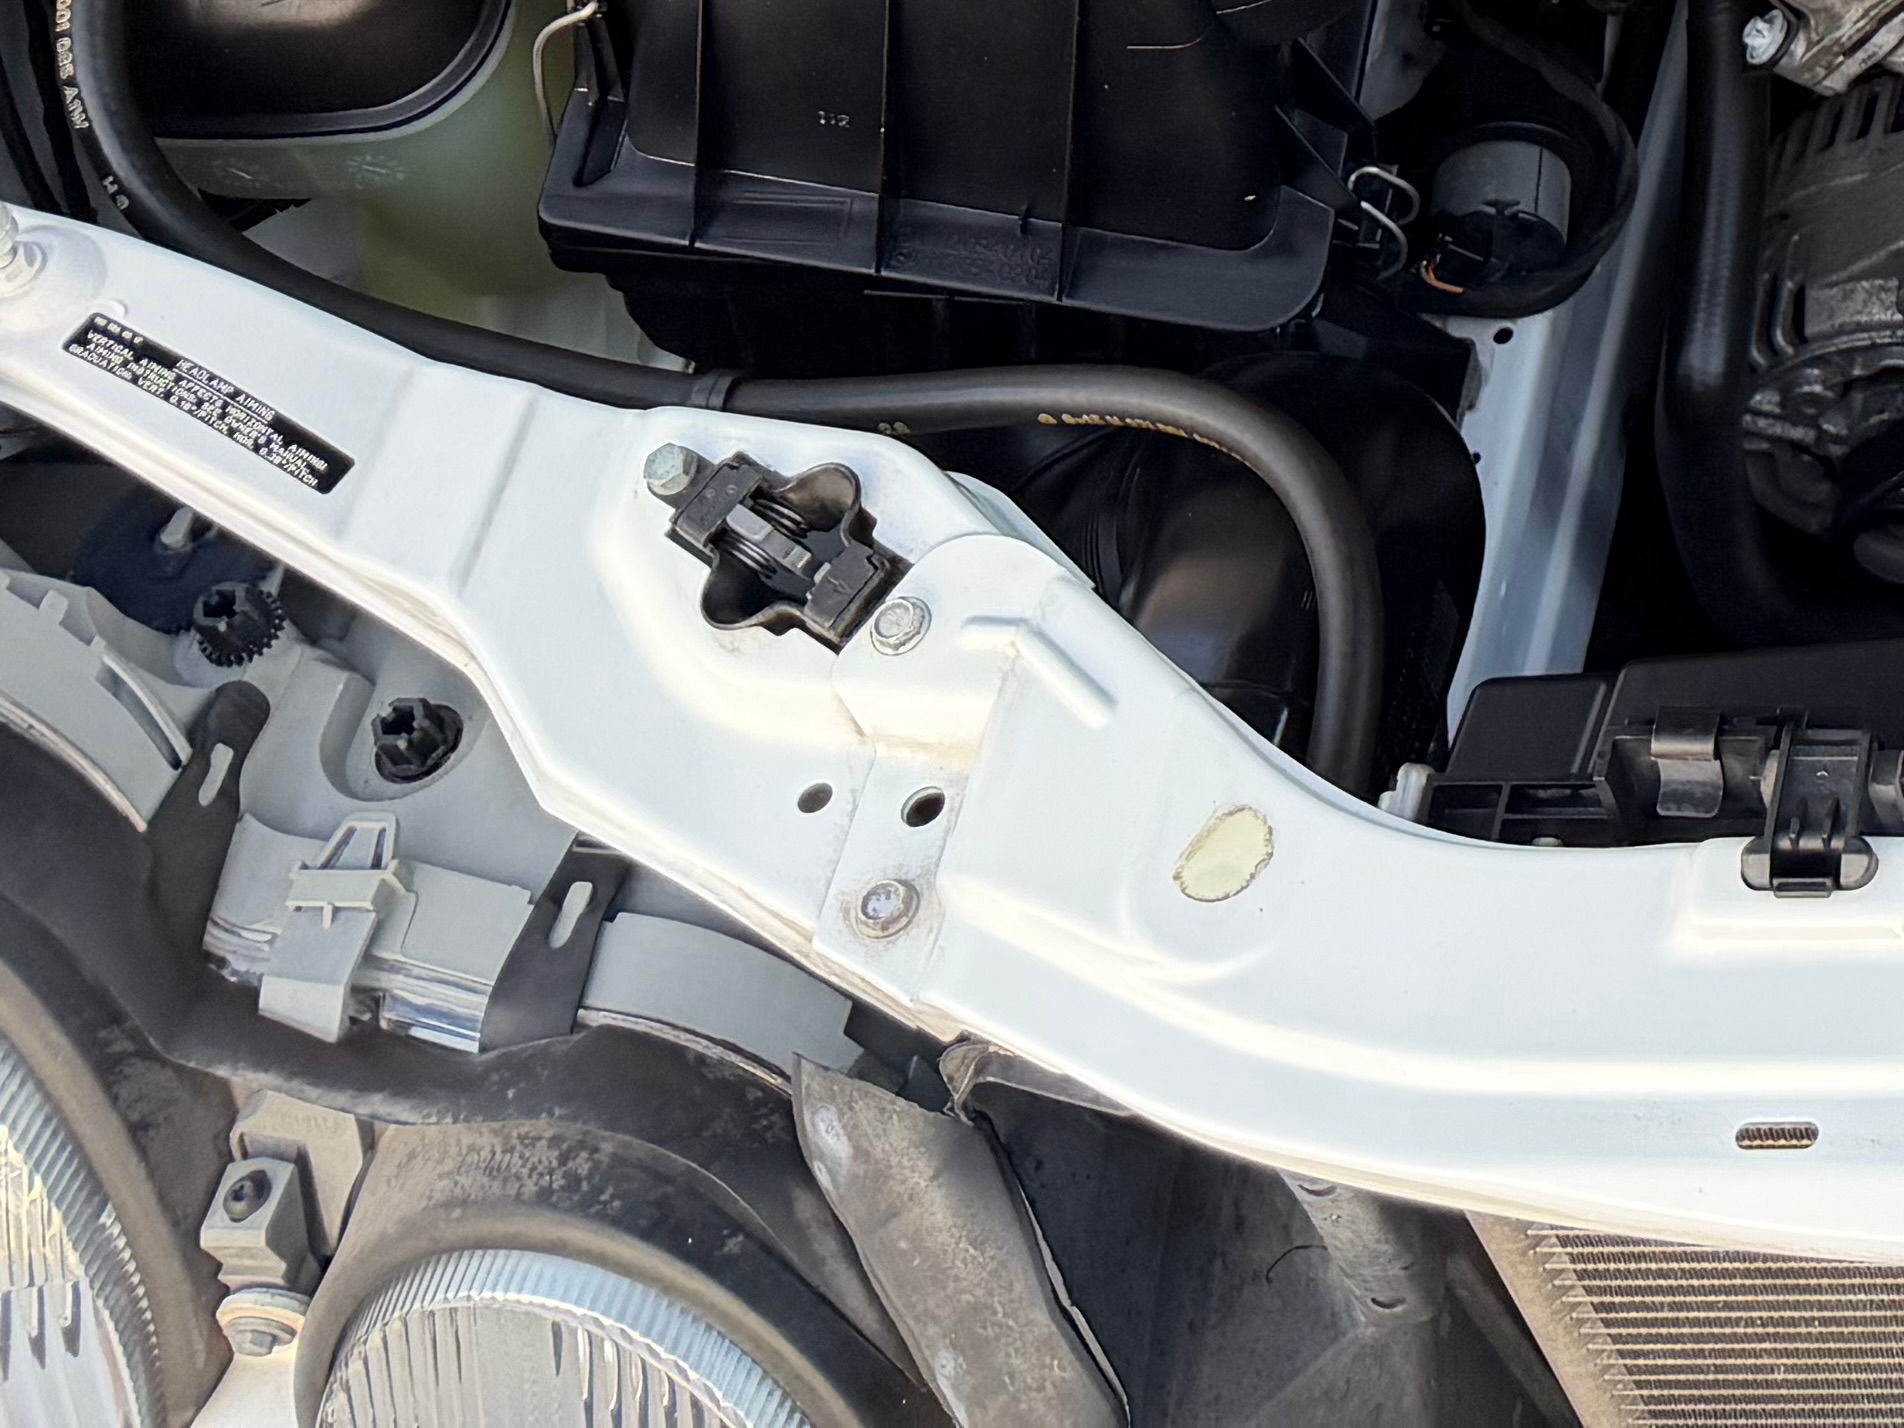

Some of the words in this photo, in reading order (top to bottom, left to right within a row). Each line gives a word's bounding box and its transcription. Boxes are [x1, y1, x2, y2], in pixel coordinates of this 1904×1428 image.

[87, 330, 134, 360] VERTICAL
[139, 357, 176, 381] AIMING
[178, 378, 223, 408] AFFECTS
[175, 359, 234, 395] HEADLAMP
[236, 392, 276, 423] AIMING
